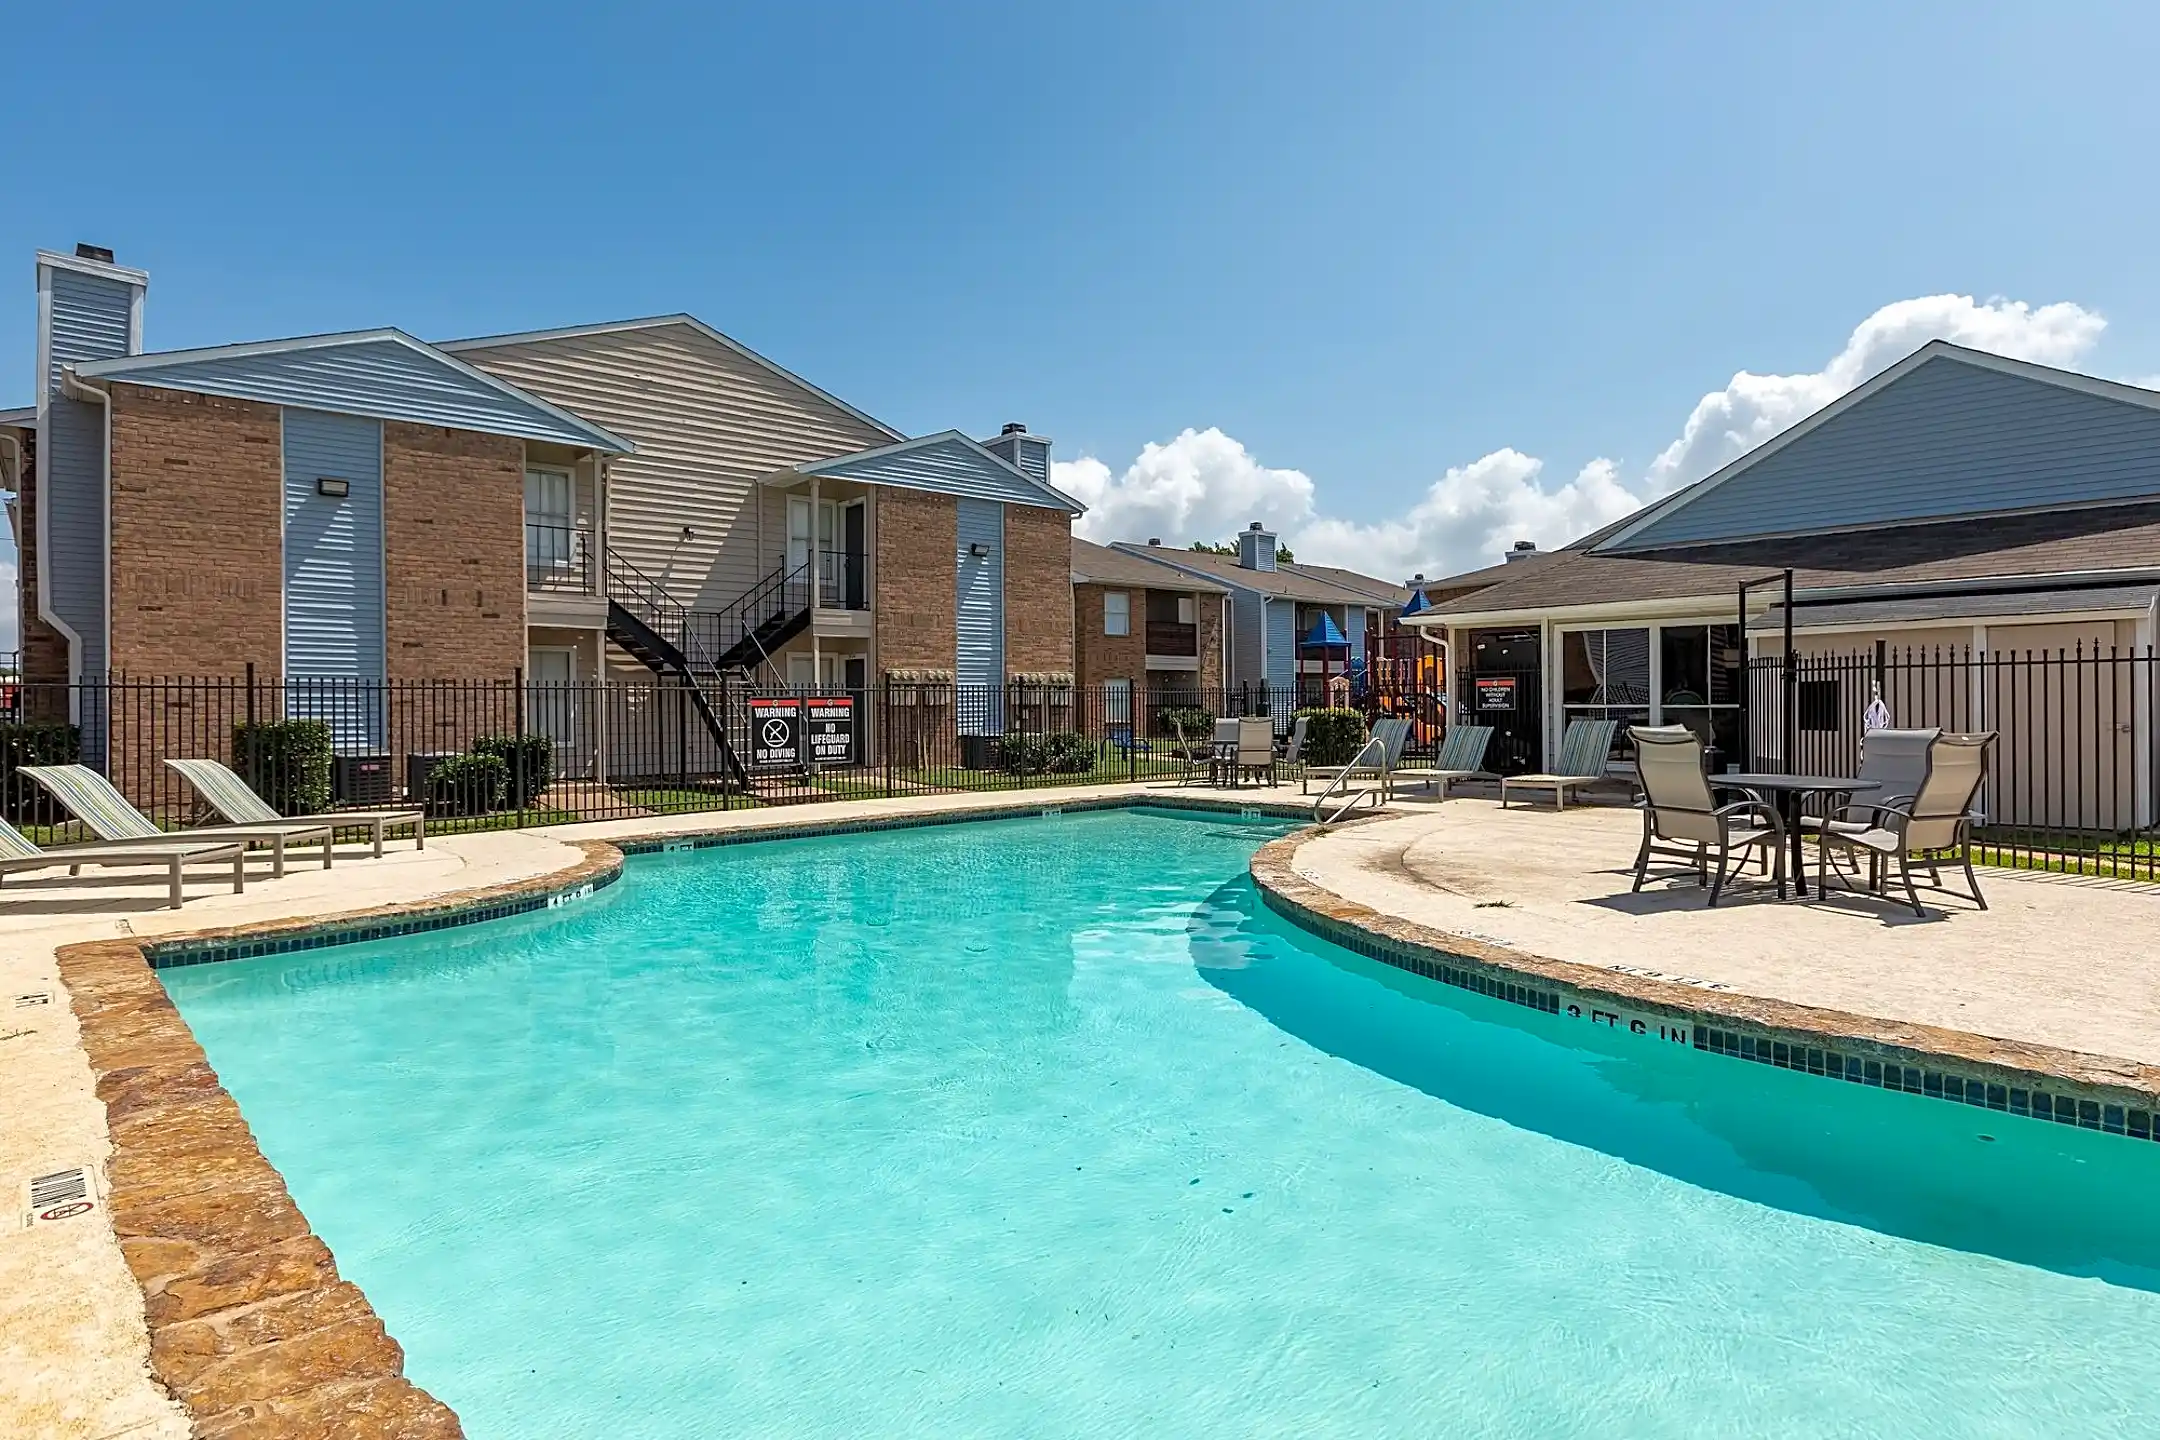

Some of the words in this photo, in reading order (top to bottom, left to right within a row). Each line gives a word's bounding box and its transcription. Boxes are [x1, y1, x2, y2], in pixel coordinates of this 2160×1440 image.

[755, 707, 796, 718] WARNING
[811, 707, 850, 718] WARNING
[825, 723, 836, 733] NO
[811, 734, 850, 744] LIFEGUARD
[756, 749, 768, 759] NO
[770, 748, 795, 758] DIVING
[815, 745, 826, 755] ON
[828, 745, 846, 755] DUTY
[1591, 1009, 1619, 1028] FT
[1660, 1025, 1686, 1044] IN
